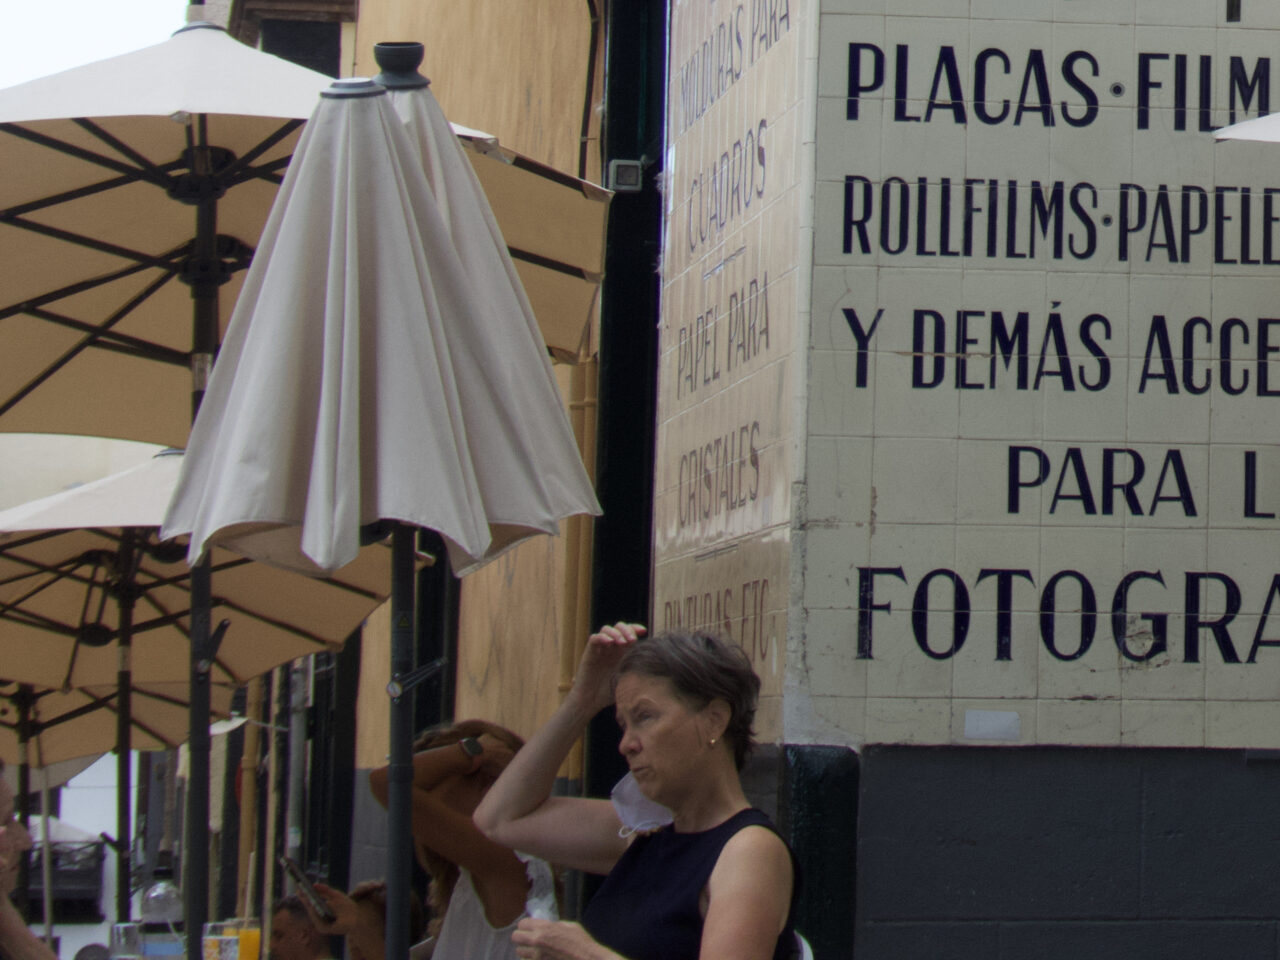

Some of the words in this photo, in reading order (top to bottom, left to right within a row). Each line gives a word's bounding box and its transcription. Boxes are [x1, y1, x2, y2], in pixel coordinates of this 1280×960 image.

[680, 4, 743, 133] MOLDURAS
[846, 42, 1100, 128] PLACAS
[688, 119, 767, 253] CUADROS
[842, 174, 1098, 260] ROLLFILMS
[677, 304, 720, 401] PAPEL
[727, 271, 769, 372] PARA
[841, 308, 885, 389] Y
[911, 300, 1112, 392] DEMÁS
[679, 420, 760, 529] CRISTALES
[1006, 445, 1198, 517] PARA
